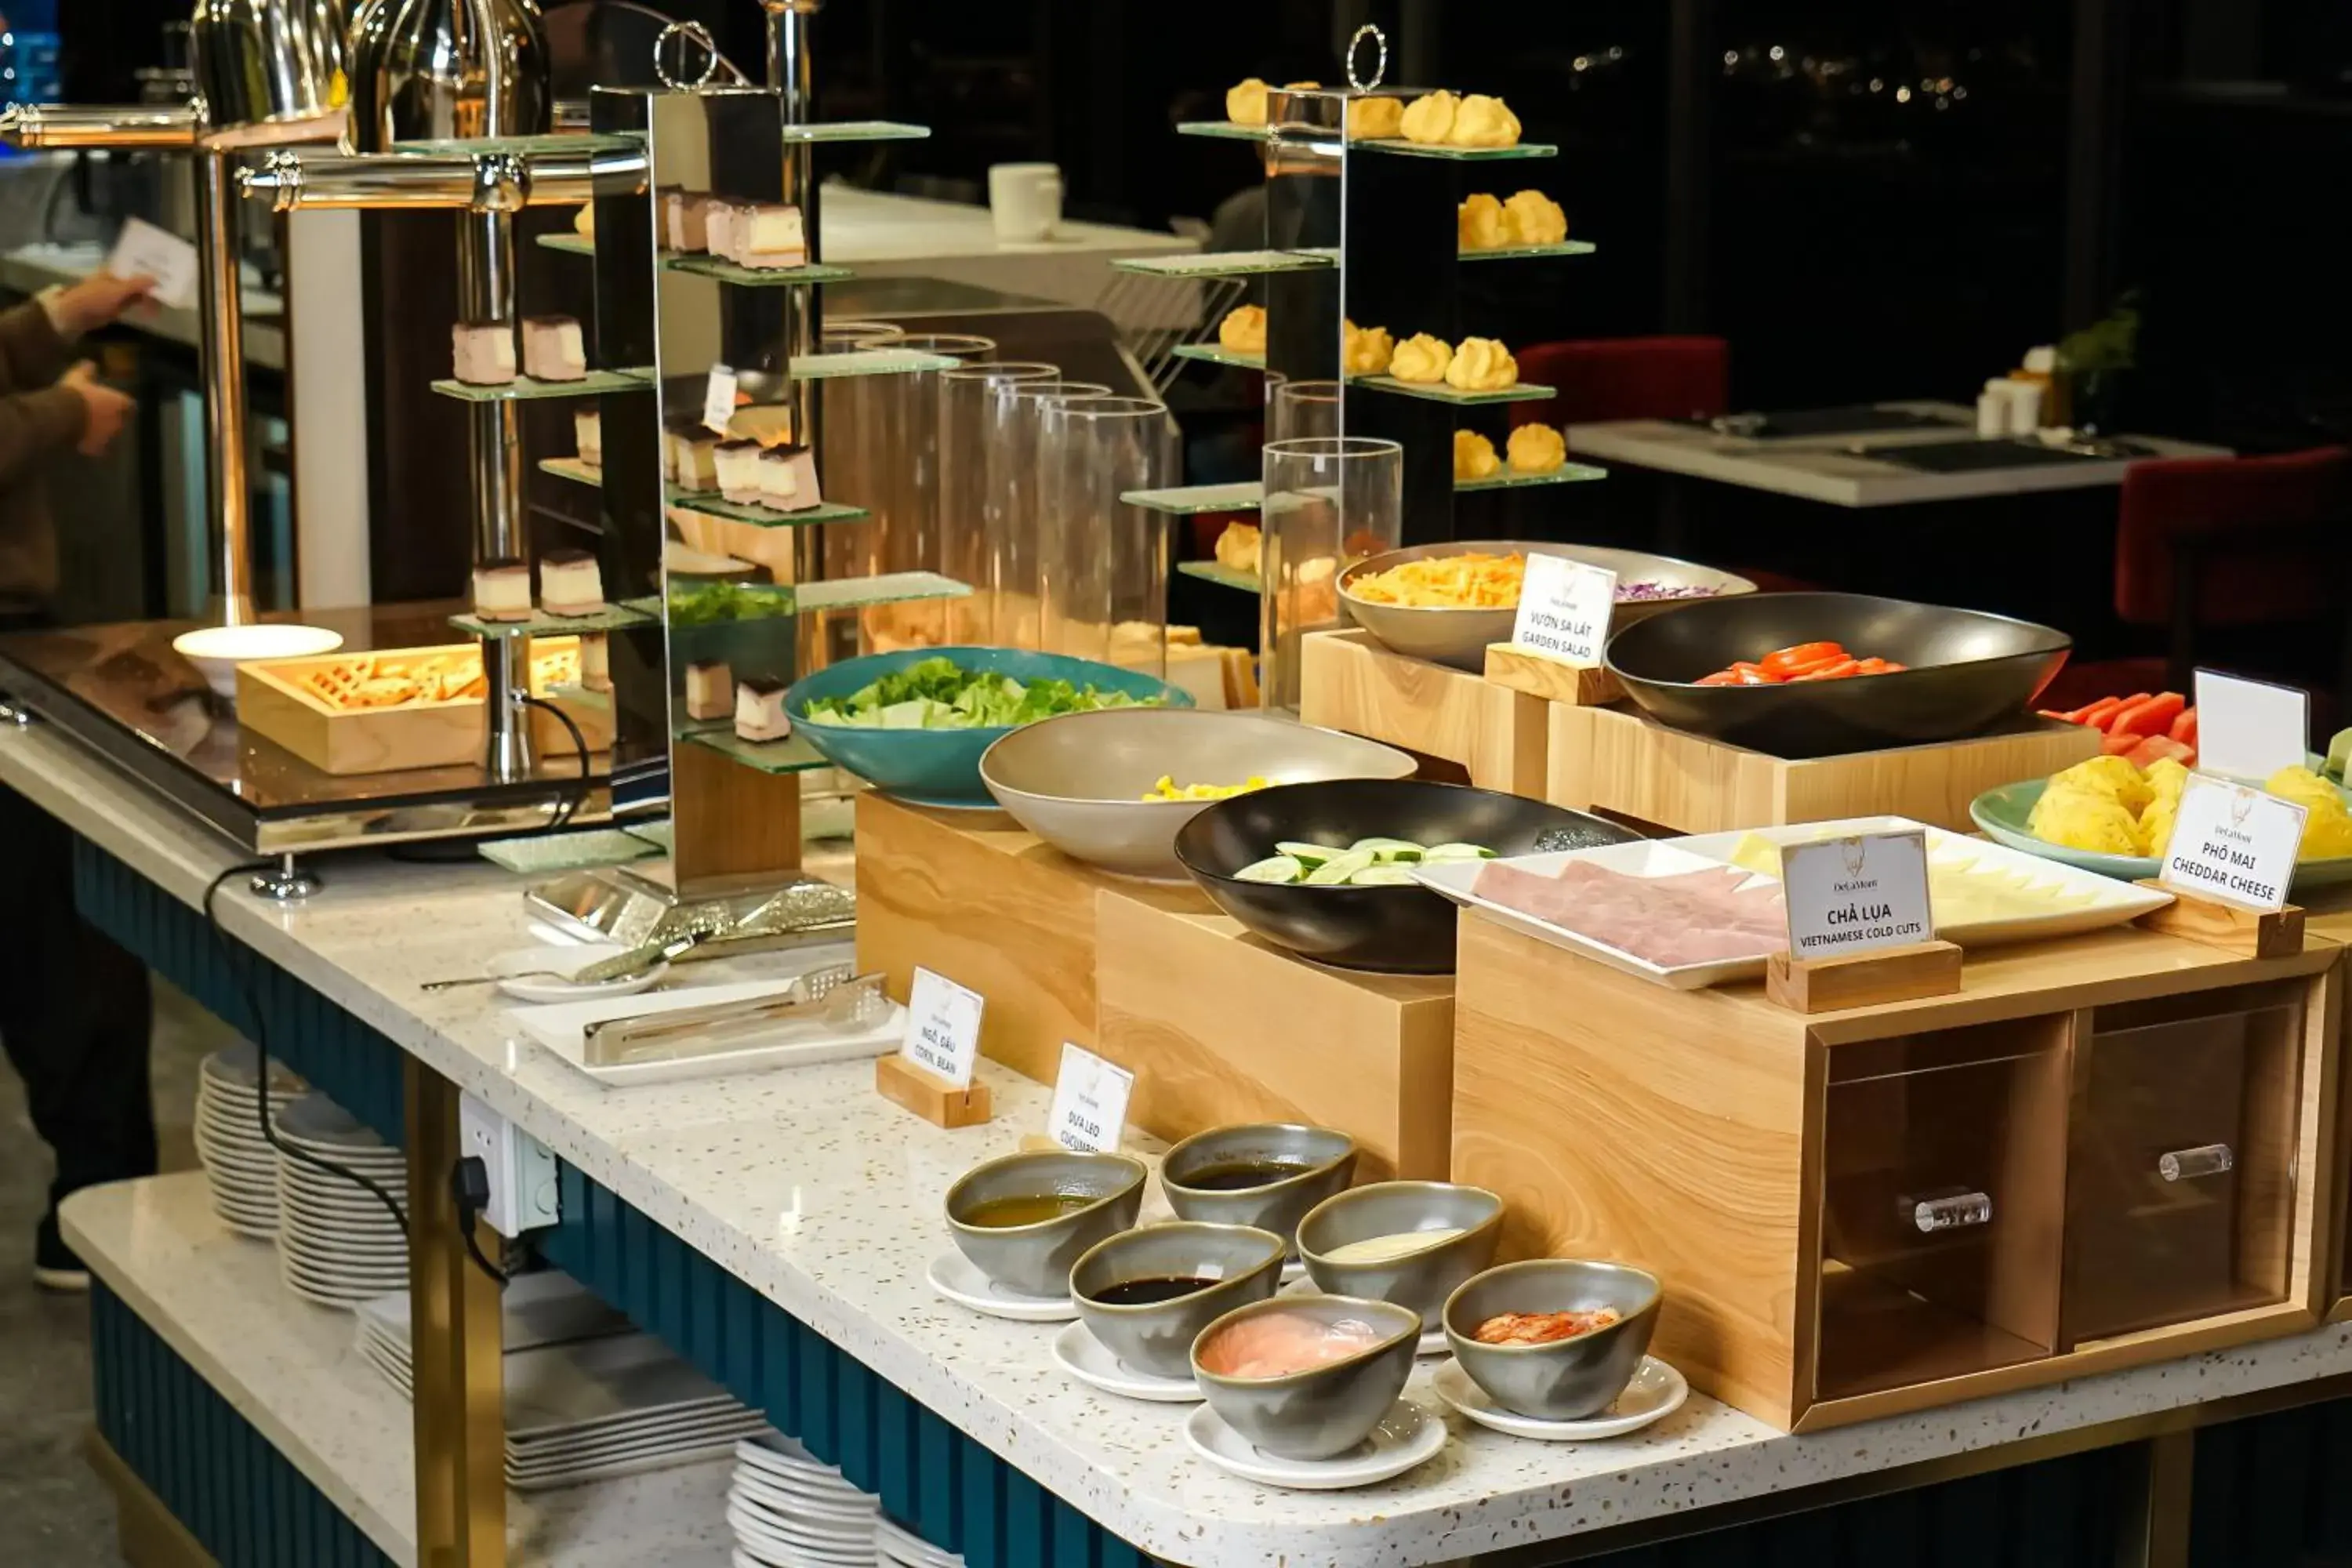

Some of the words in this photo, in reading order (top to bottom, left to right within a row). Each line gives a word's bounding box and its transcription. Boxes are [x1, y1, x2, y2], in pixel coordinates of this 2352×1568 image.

[1559, 619, 1572, 633] SA
[1523, 630, 1559, 650] GARDEN
[1561, 640, 1592, 659] SALAD
[2230, 851, 2256, 869] MAI
[2172, 857, 2227, 885] CHEDDAR
[2230, 875, 2275, 901] CHEESE
[1828, 902, 1858, 925] CHẢ
[1862, 904, 1892, 923] LỤA
[1801, 929, 1864, 948] VIETNAMESE
[1866, 926, 1893, 938] COLD
[1896, 922, 1922, 935] CUTS
[936, 1055, 956, 1075] BEAN
[1084, 1119, 1100, 1138] LEO
